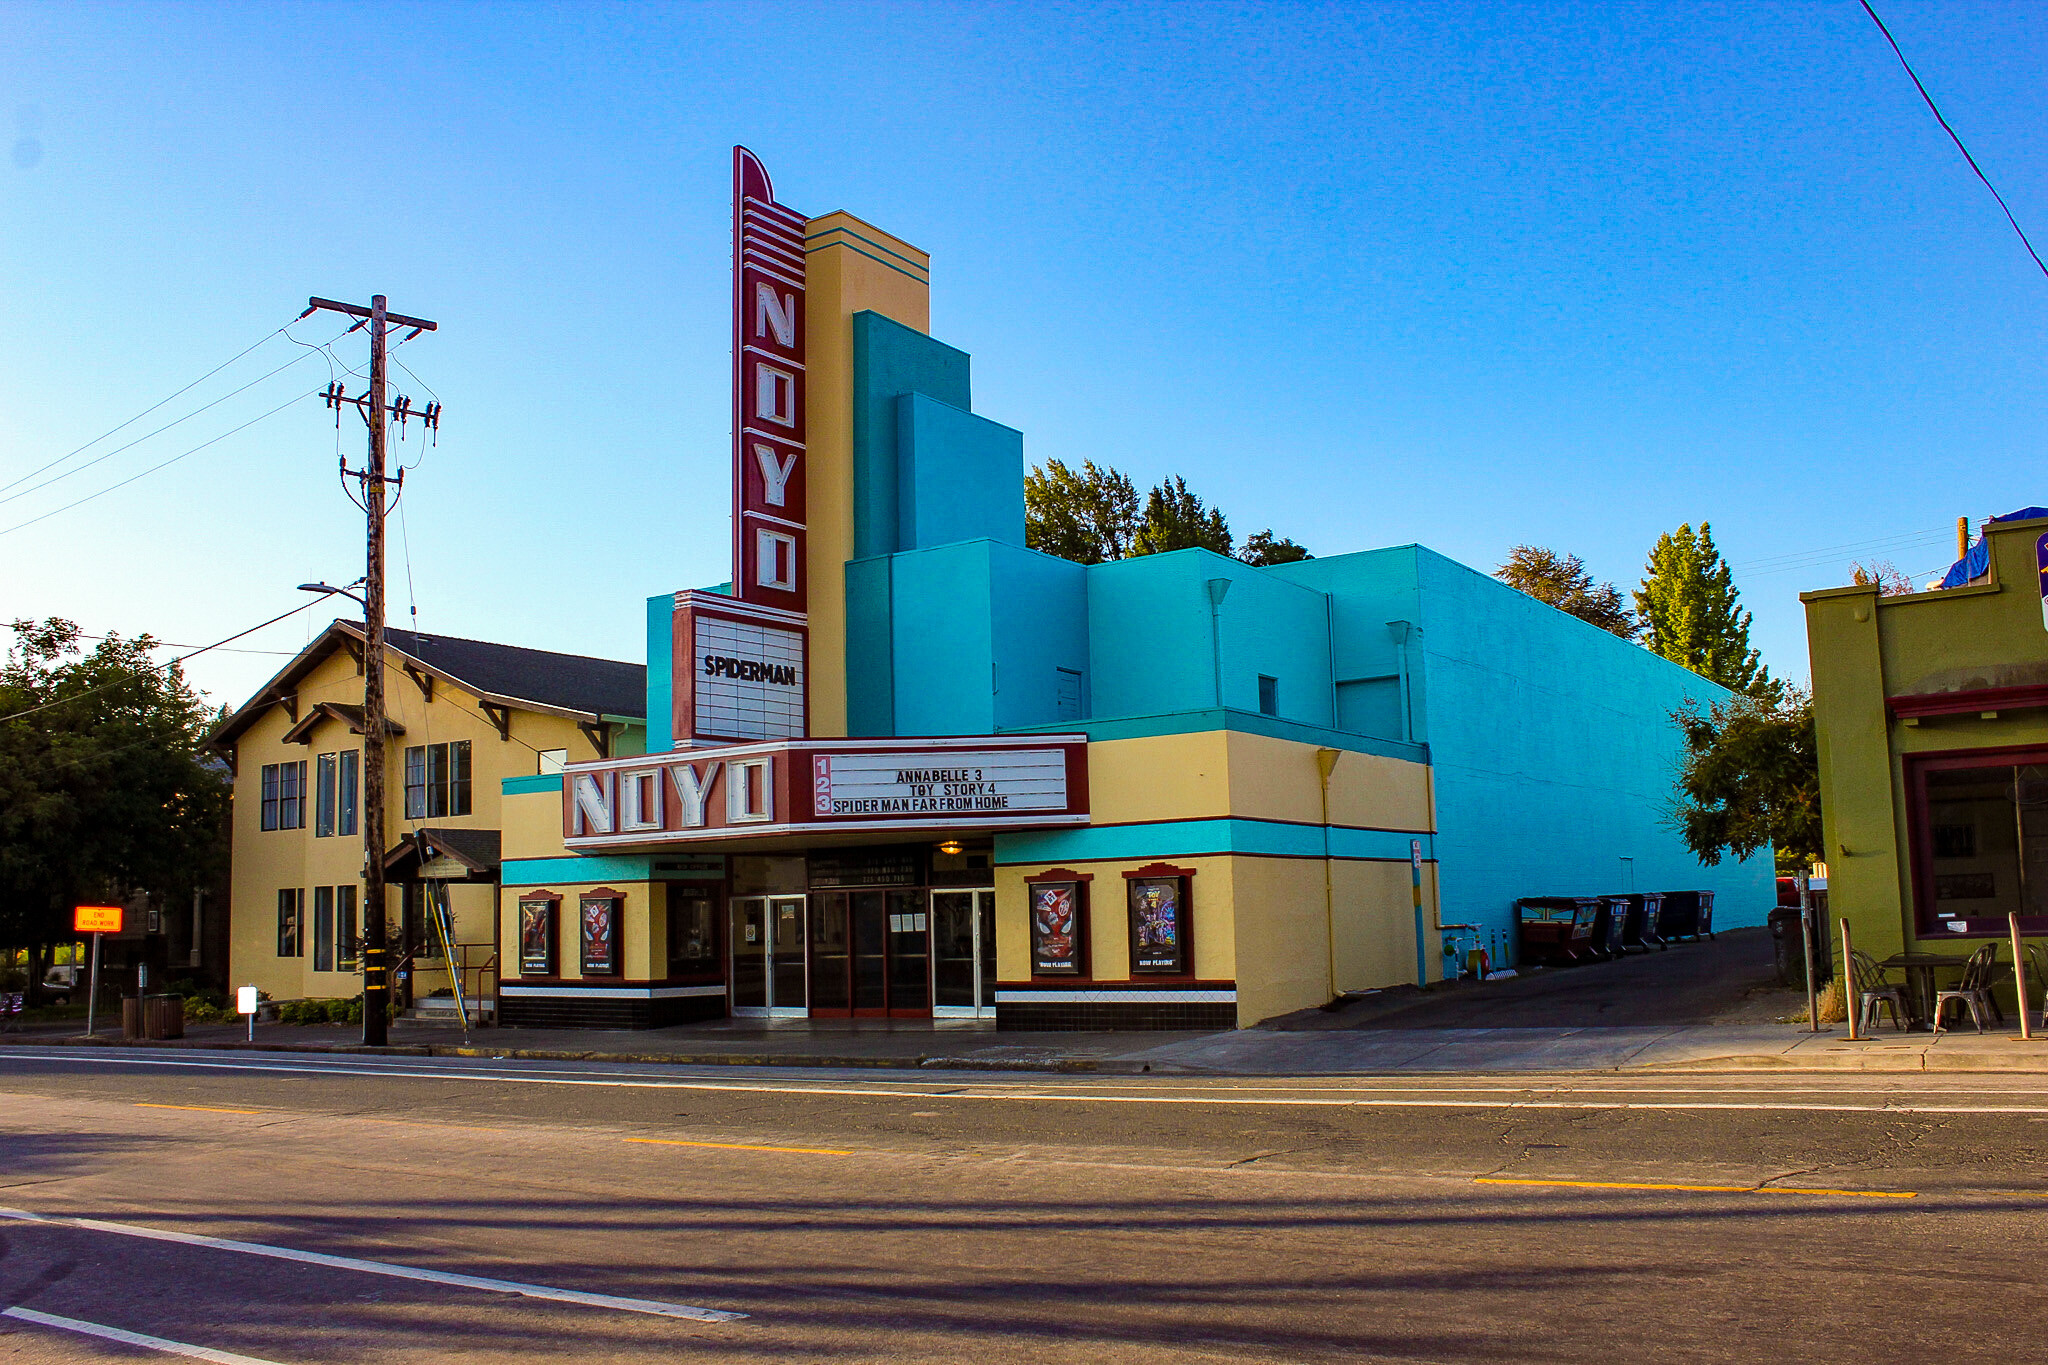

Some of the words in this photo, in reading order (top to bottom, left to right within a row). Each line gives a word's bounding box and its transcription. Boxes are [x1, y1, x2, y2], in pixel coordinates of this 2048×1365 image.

[753, 281, 797, 593] NOYO
[704, 654, 796, 686] SPIDERMAN
[817, 759, 827, 774] 1
[897, 769, 968, 783] ANNABELLE
[974, 769, 982, 780] 3
[816, 777, 830, 792] 2
[910, 784, 934, 796] TOY
[944, 783, 984, 796] STORY
[988, 783, 996, 794] 4
[572, 755, 774, 835] NOYO
[817, 795, 830, 811] 3
[834, 800, 878, 812] SPIDER
[912, 798, 938, 810] FAR
[940, 797, 972, 810] FROM
[976, 796, 1008, 808] HOME
